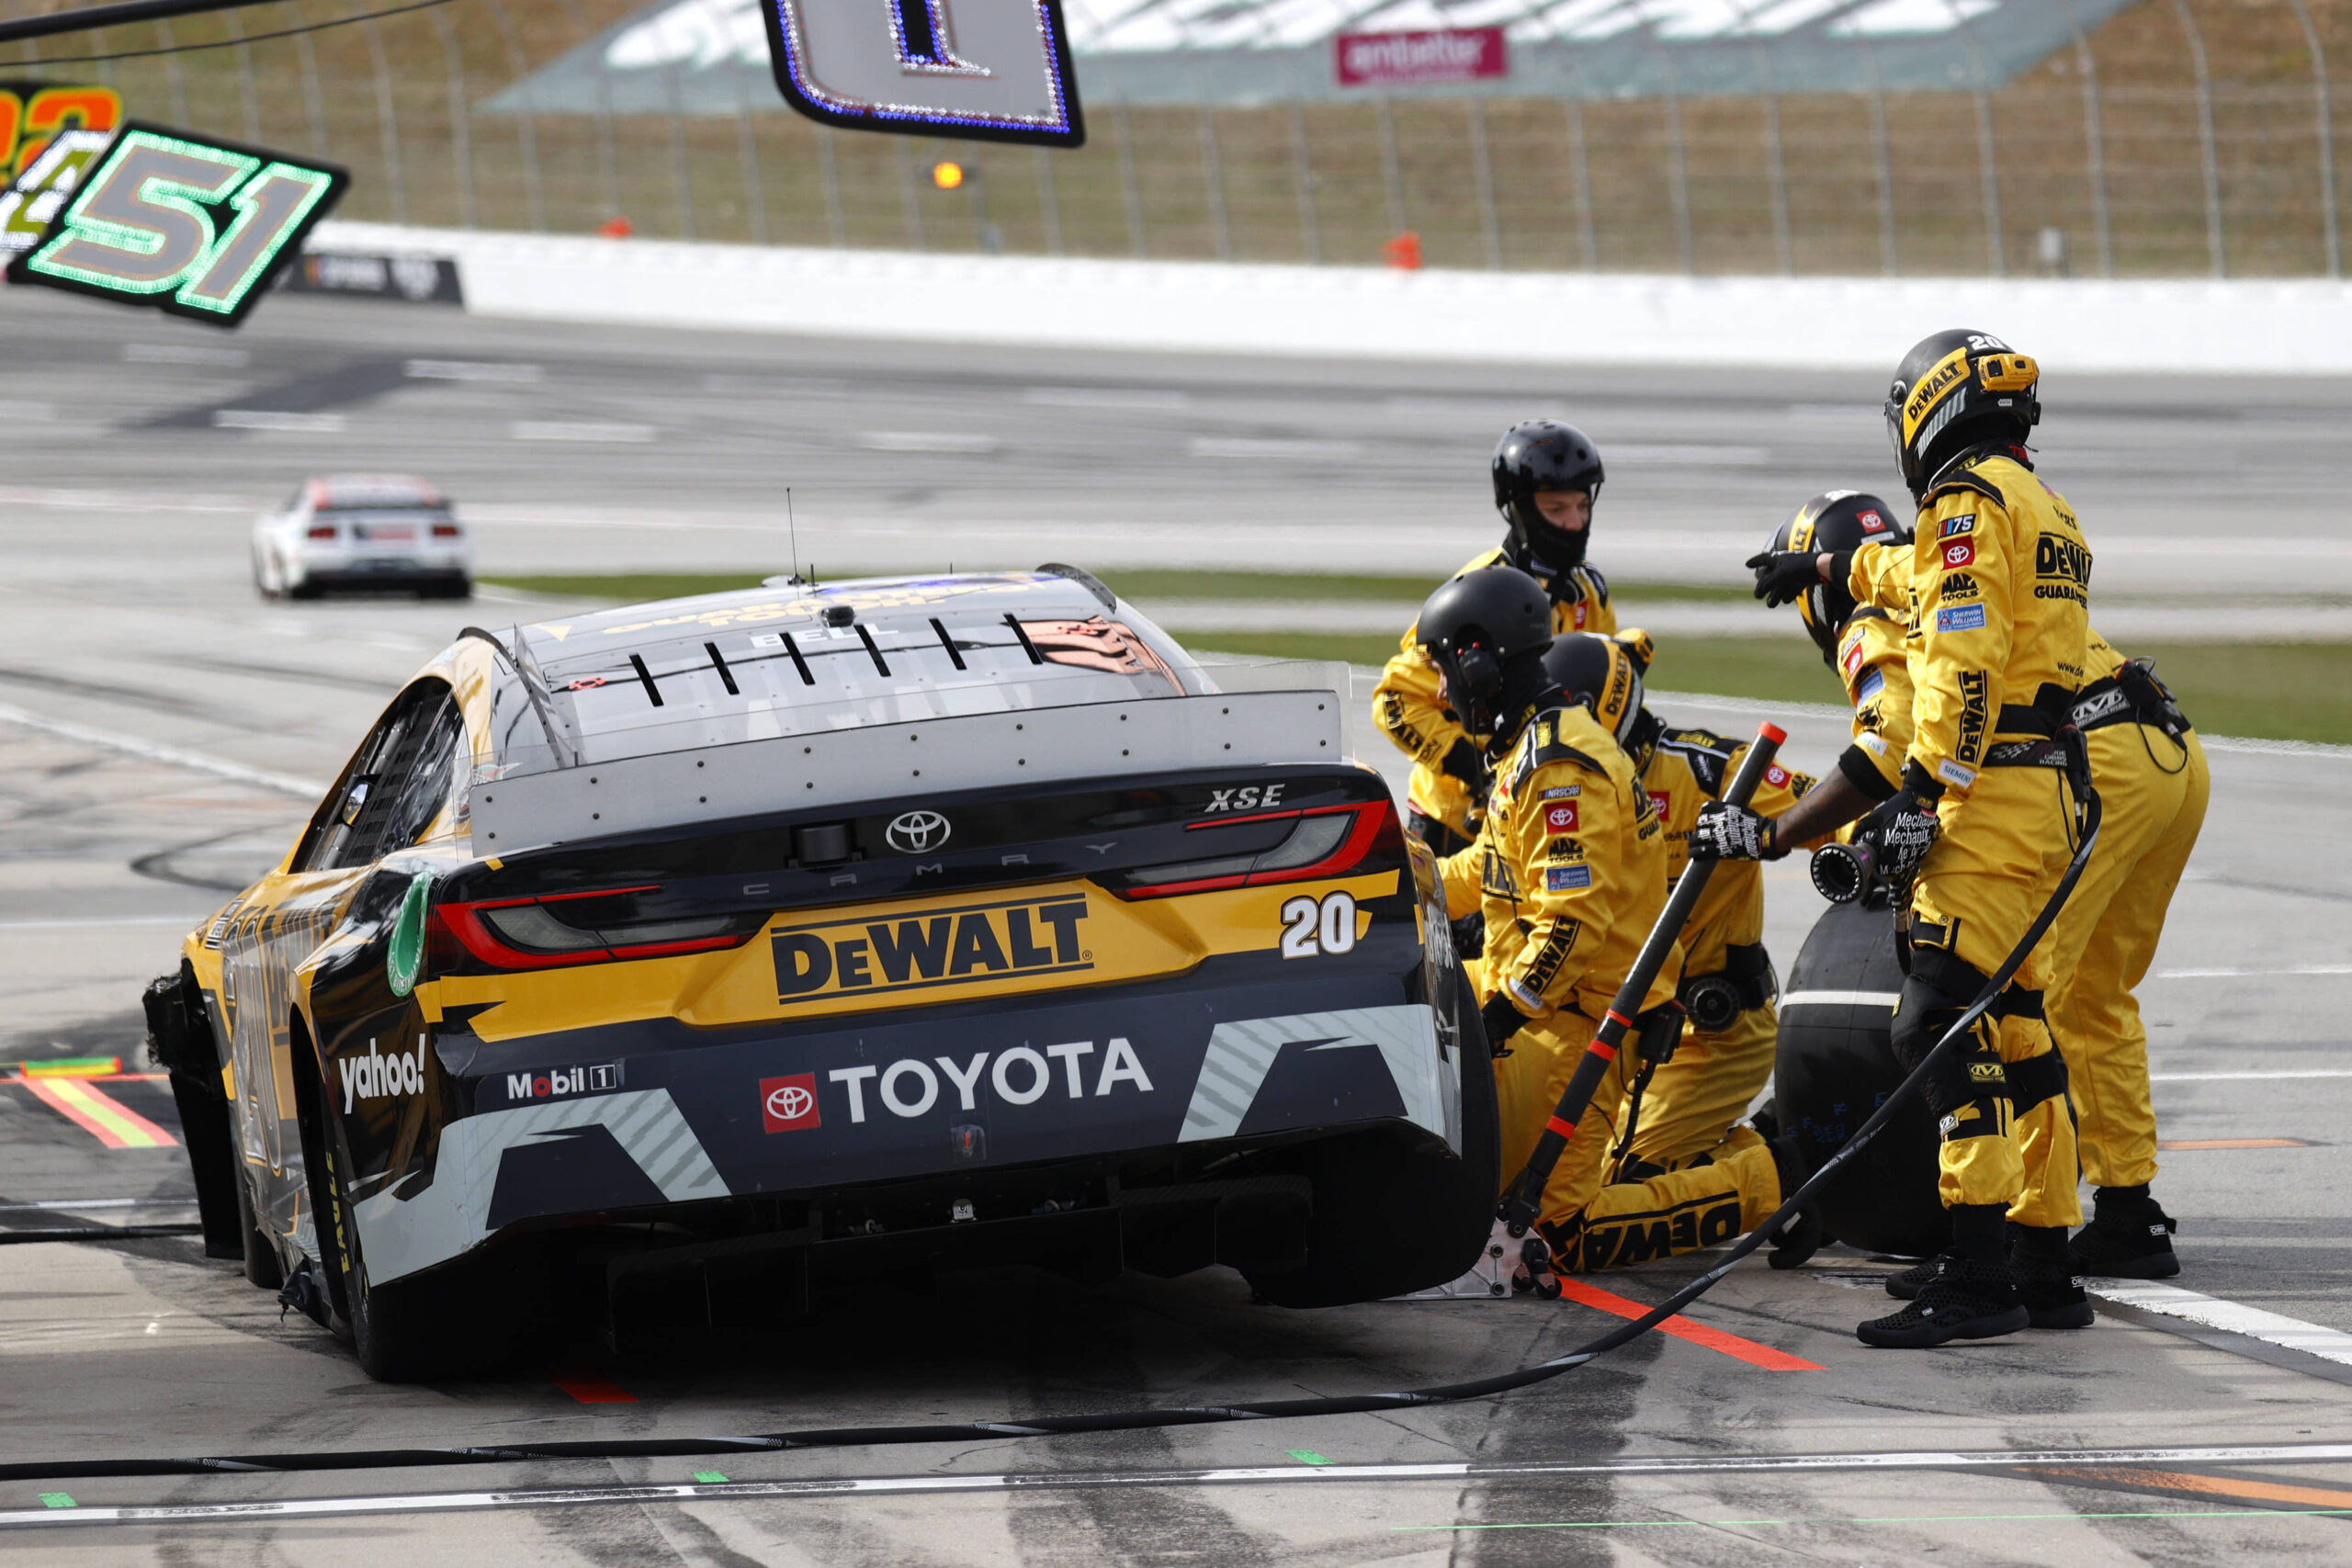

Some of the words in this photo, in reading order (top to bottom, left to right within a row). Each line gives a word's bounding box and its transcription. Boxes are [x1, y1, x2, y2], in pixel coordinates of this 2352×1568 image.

[28, 129, 333, 314] 51
[1967, 334, 2007, 351] 20
[1908, 362, 1961, 419] DEWALT
[1952, 515, 1973, 534] 75
[1941, 572, 1977, 596] MAC
[1941, 589, 1979, 602] TOOLS
[751, 623, 899, 649] BELL
[1959, 670, 1984, 763] DEWALT
[1204, 783, 1285, 812] XSE
[1548, 785, 1580, 798] NASCAR
[1883, 827, 1930, 847] Mechanix
[742, 840, 1118, 896] CAMRY
[1549, 853, 1584, 863] TOOLS
[1280, 890, 1358, 960] 20
[771, 900, 1088, 997] DEWALT
[1523, 915, 1577, 994] DEWALT
[338, 1032, 426, 1114] yahoo!
[507, 1066, 585, 1100] Mobil
[829, 1037, 1154, 1123] TOYOTA
